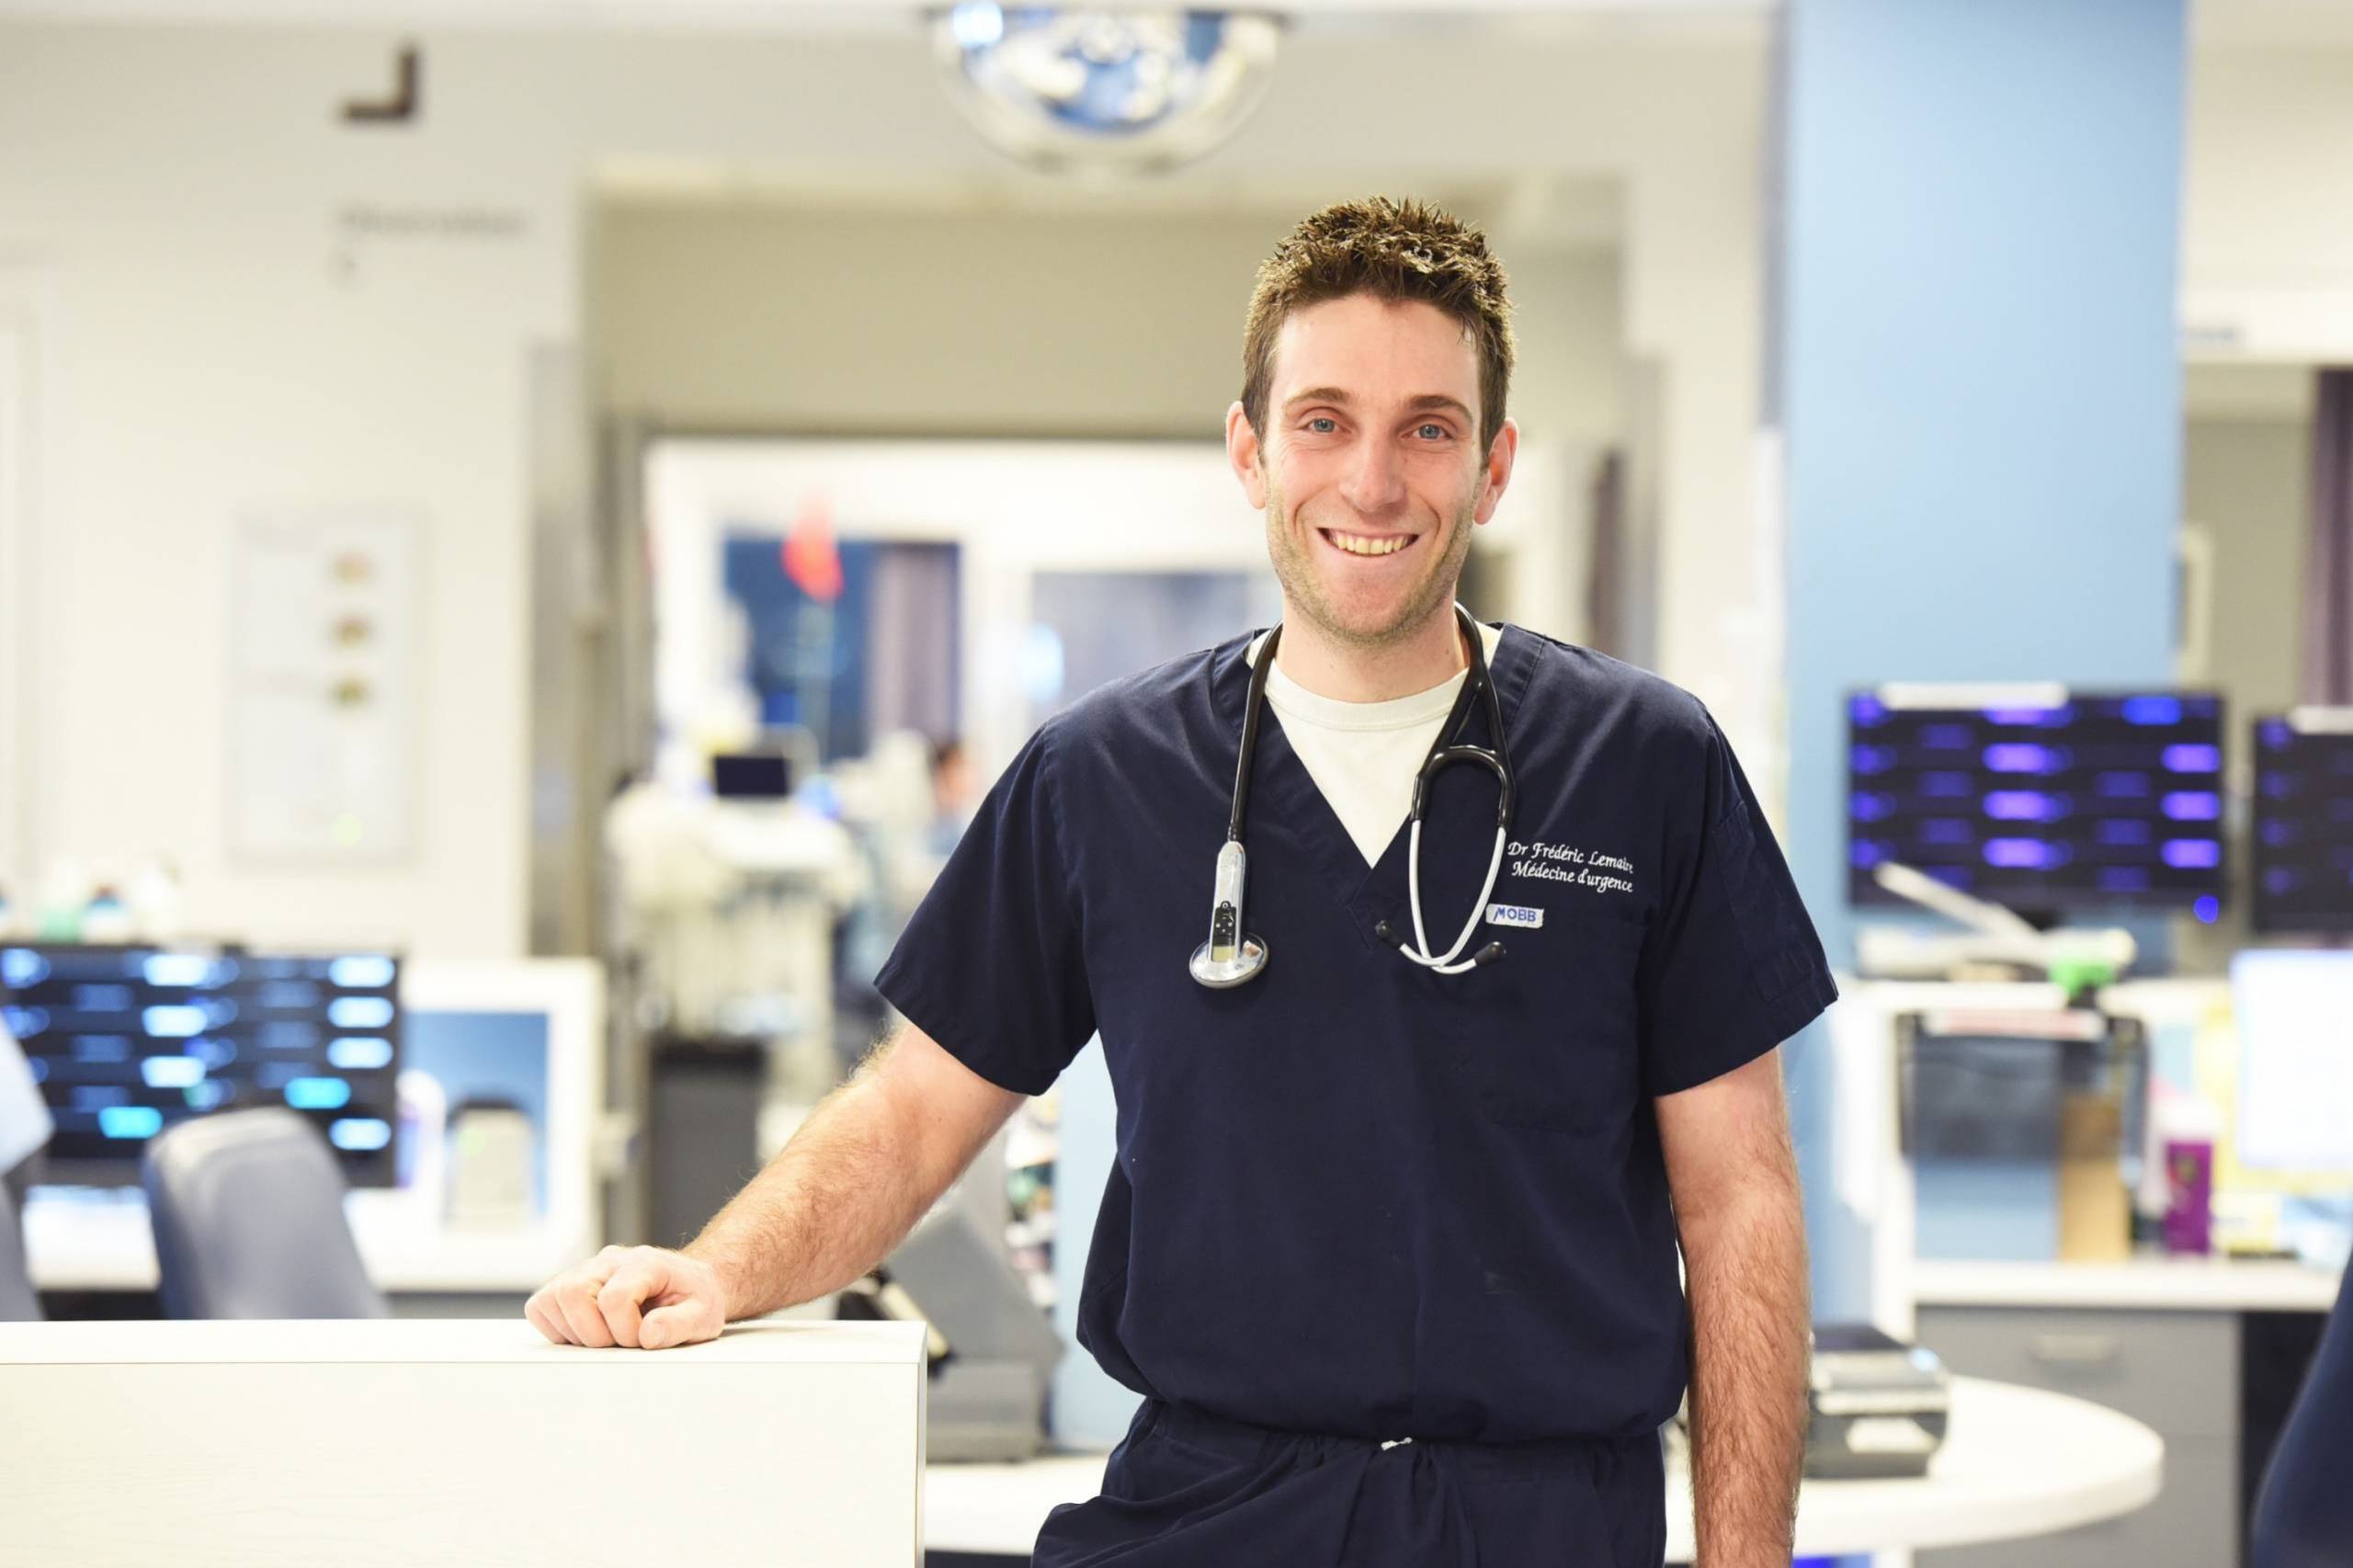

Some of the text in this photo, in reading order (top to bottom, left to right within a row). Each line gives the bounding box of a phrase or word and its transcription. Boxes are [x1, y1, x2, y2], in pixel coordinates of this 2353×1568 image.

[1507, 841, 1529, 856] Dr
[1530, 842, 1585, 864] Frédéric
[1511, 859, 1633, 893] Médecine d'urgence
[1493, 906, 1536, 922] MOBB
